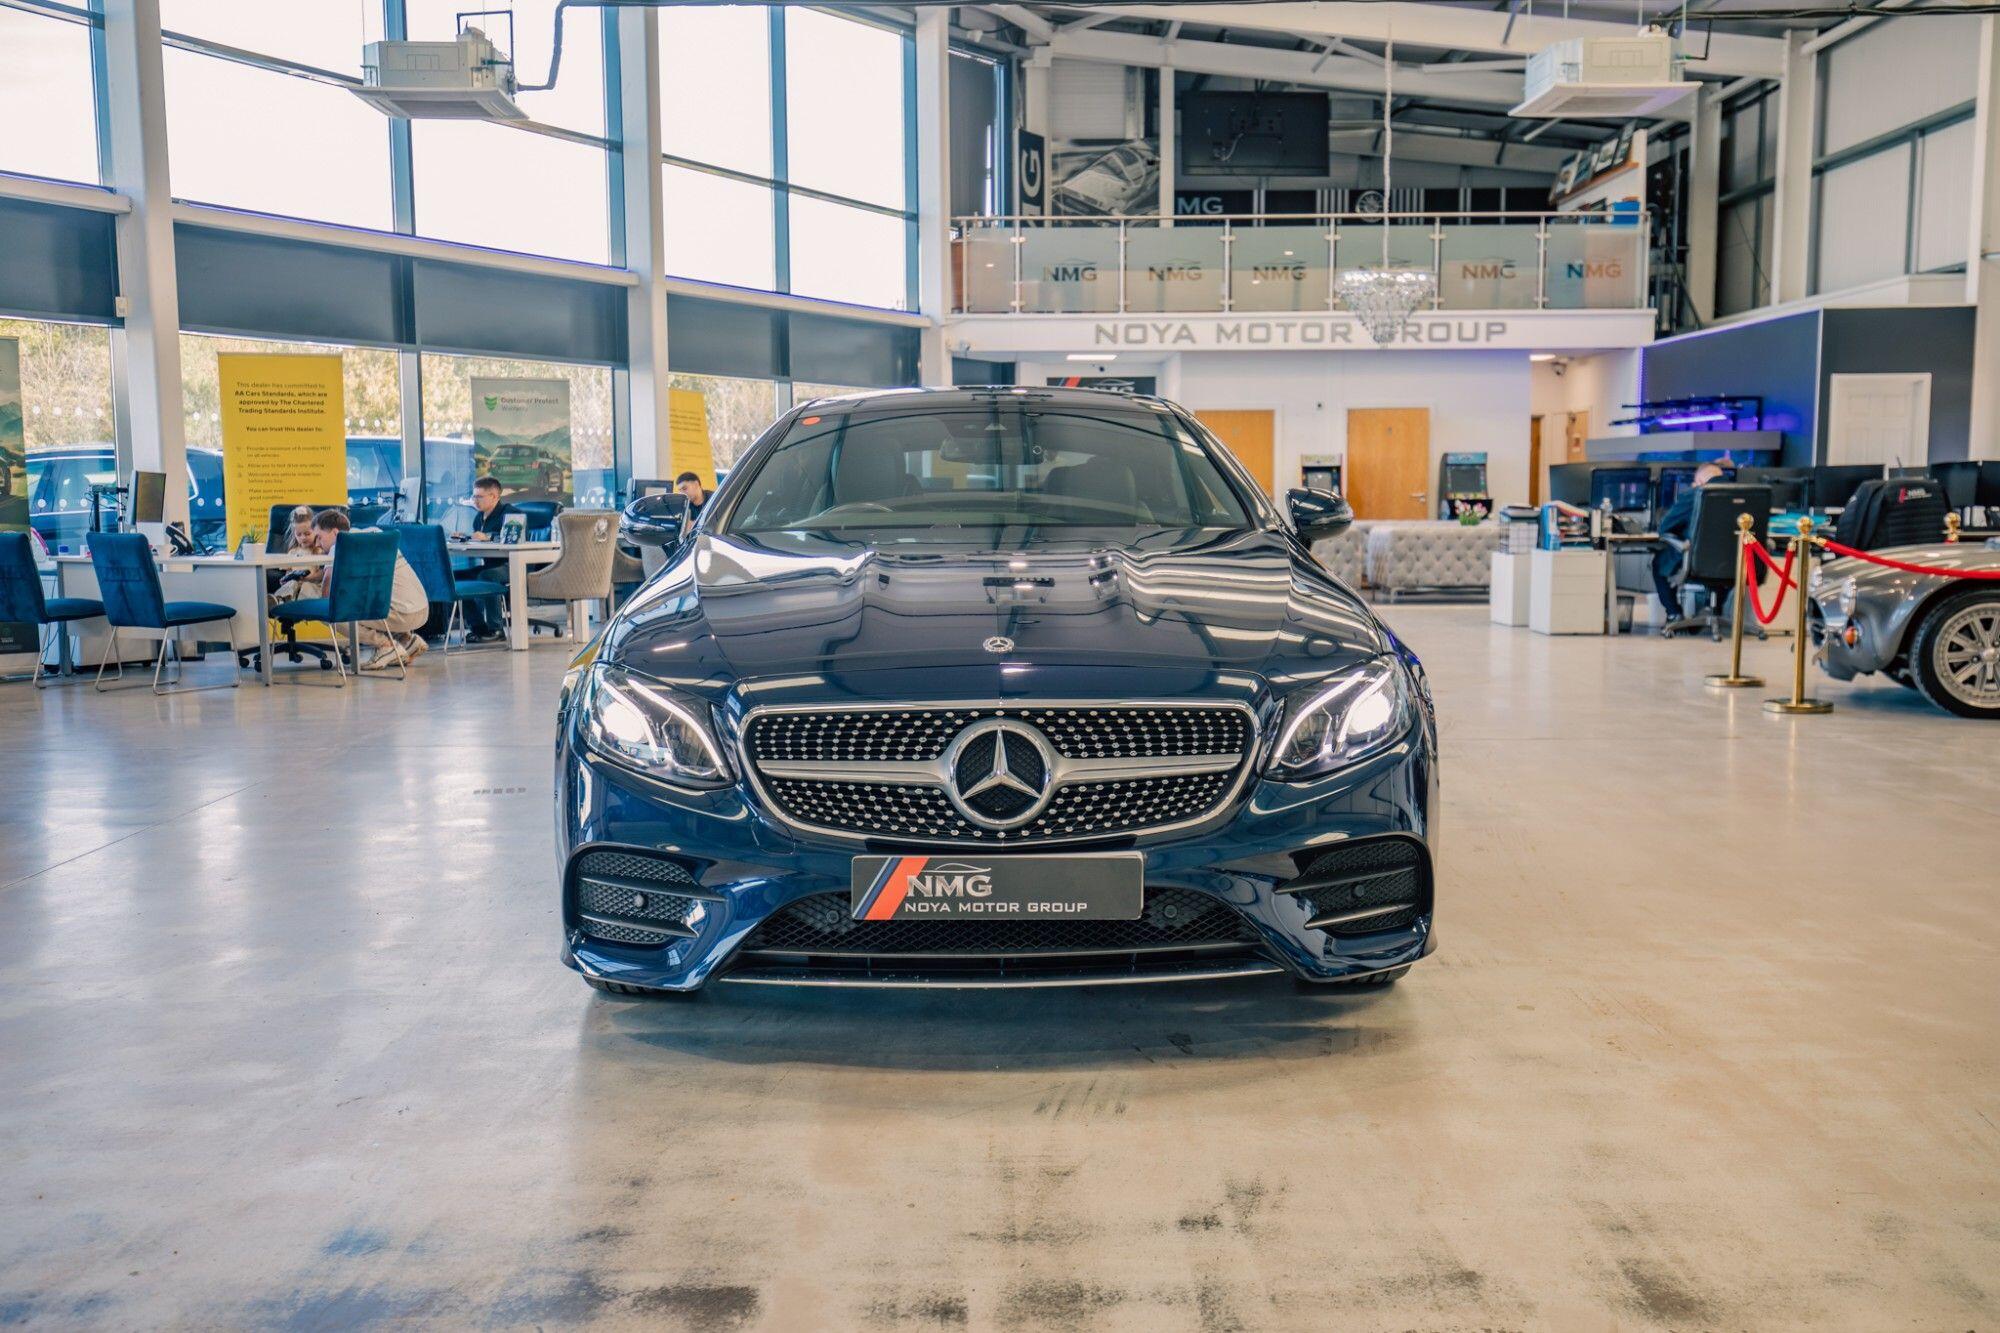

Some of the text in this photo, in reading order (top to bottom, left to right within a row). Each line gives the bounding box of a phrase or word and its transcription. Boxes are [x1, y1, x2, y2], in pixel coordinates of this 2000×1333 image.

[1043, 266, 1098, 281] NMG
[1149, 266, 1202, 281] NMG
[1252, 266, 1307, 281] NMG
[1461, 264, 1516, 279] NMG
[1566, 263, 1622, 279] NMG
[1095, 321, 1507, 344] NOYA MOTOR ROUP
[906, 874, 992, 897] NMG
[905, 902, 1088, 913] NOYA MOTOR GROUP
